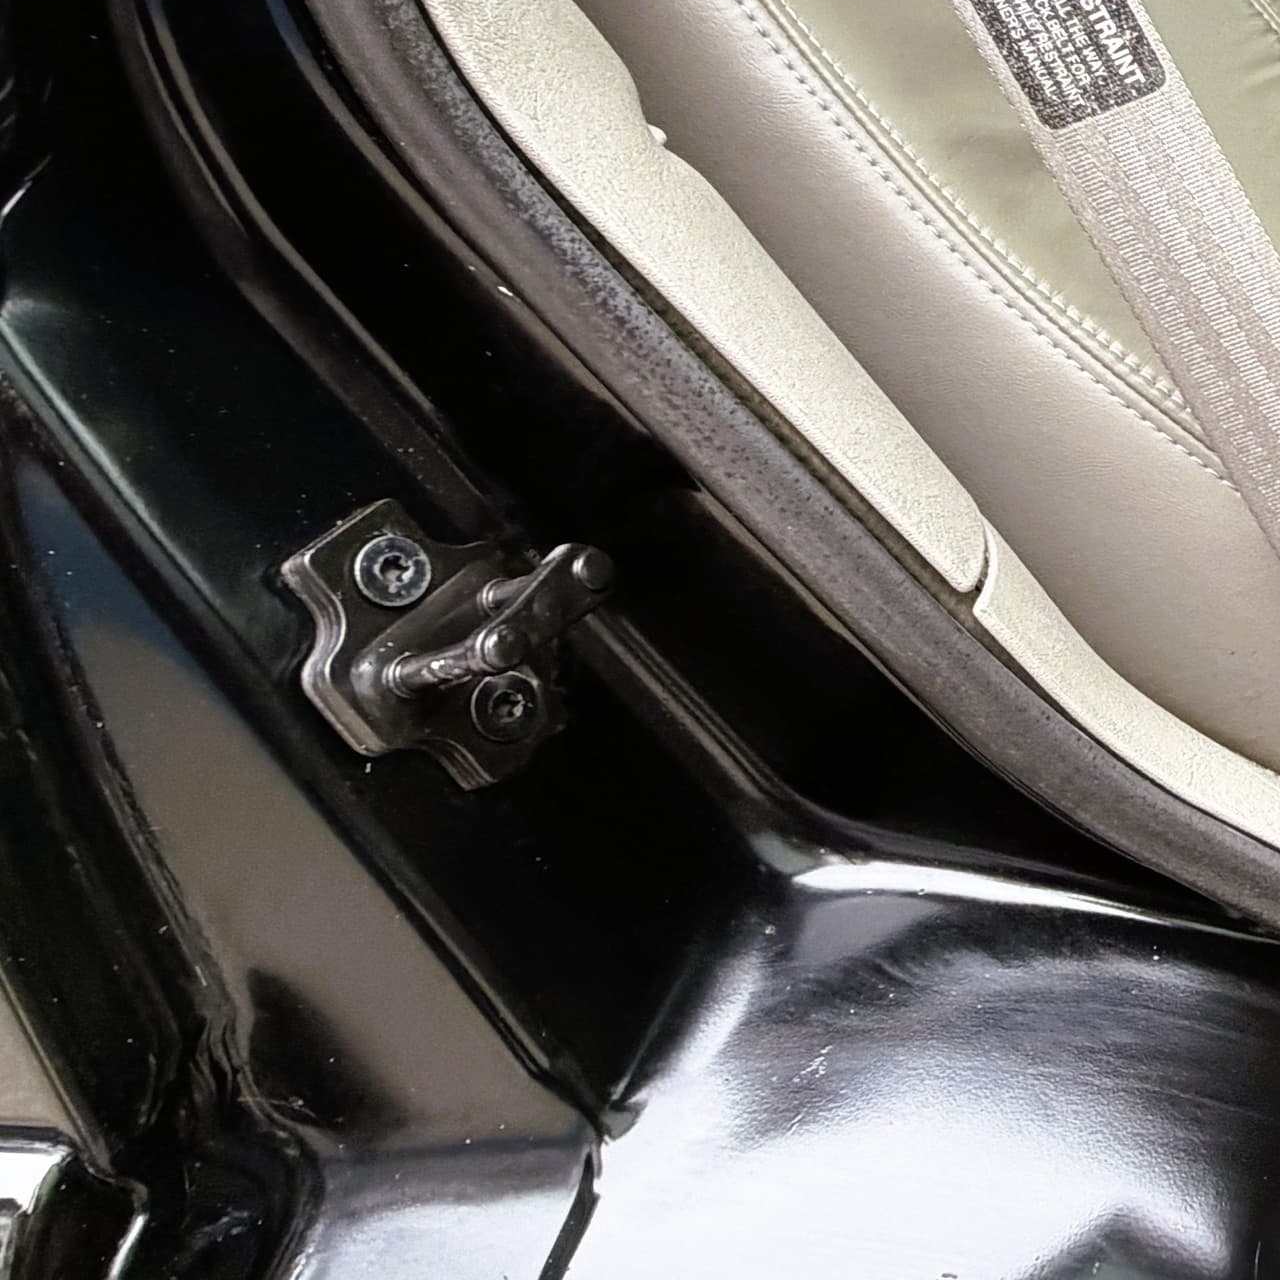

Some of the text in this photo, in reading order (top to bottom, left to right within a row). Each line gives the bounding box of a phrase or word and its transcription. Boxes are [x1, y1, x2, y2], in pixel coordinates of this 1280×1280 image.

[1046, 20, 1073, 55] BELT
[1066, 55, 1090, 85] FOR
[1067, 18, 1089, 47] THE
[1038, 31, 1085, 107] RESTRAINT
